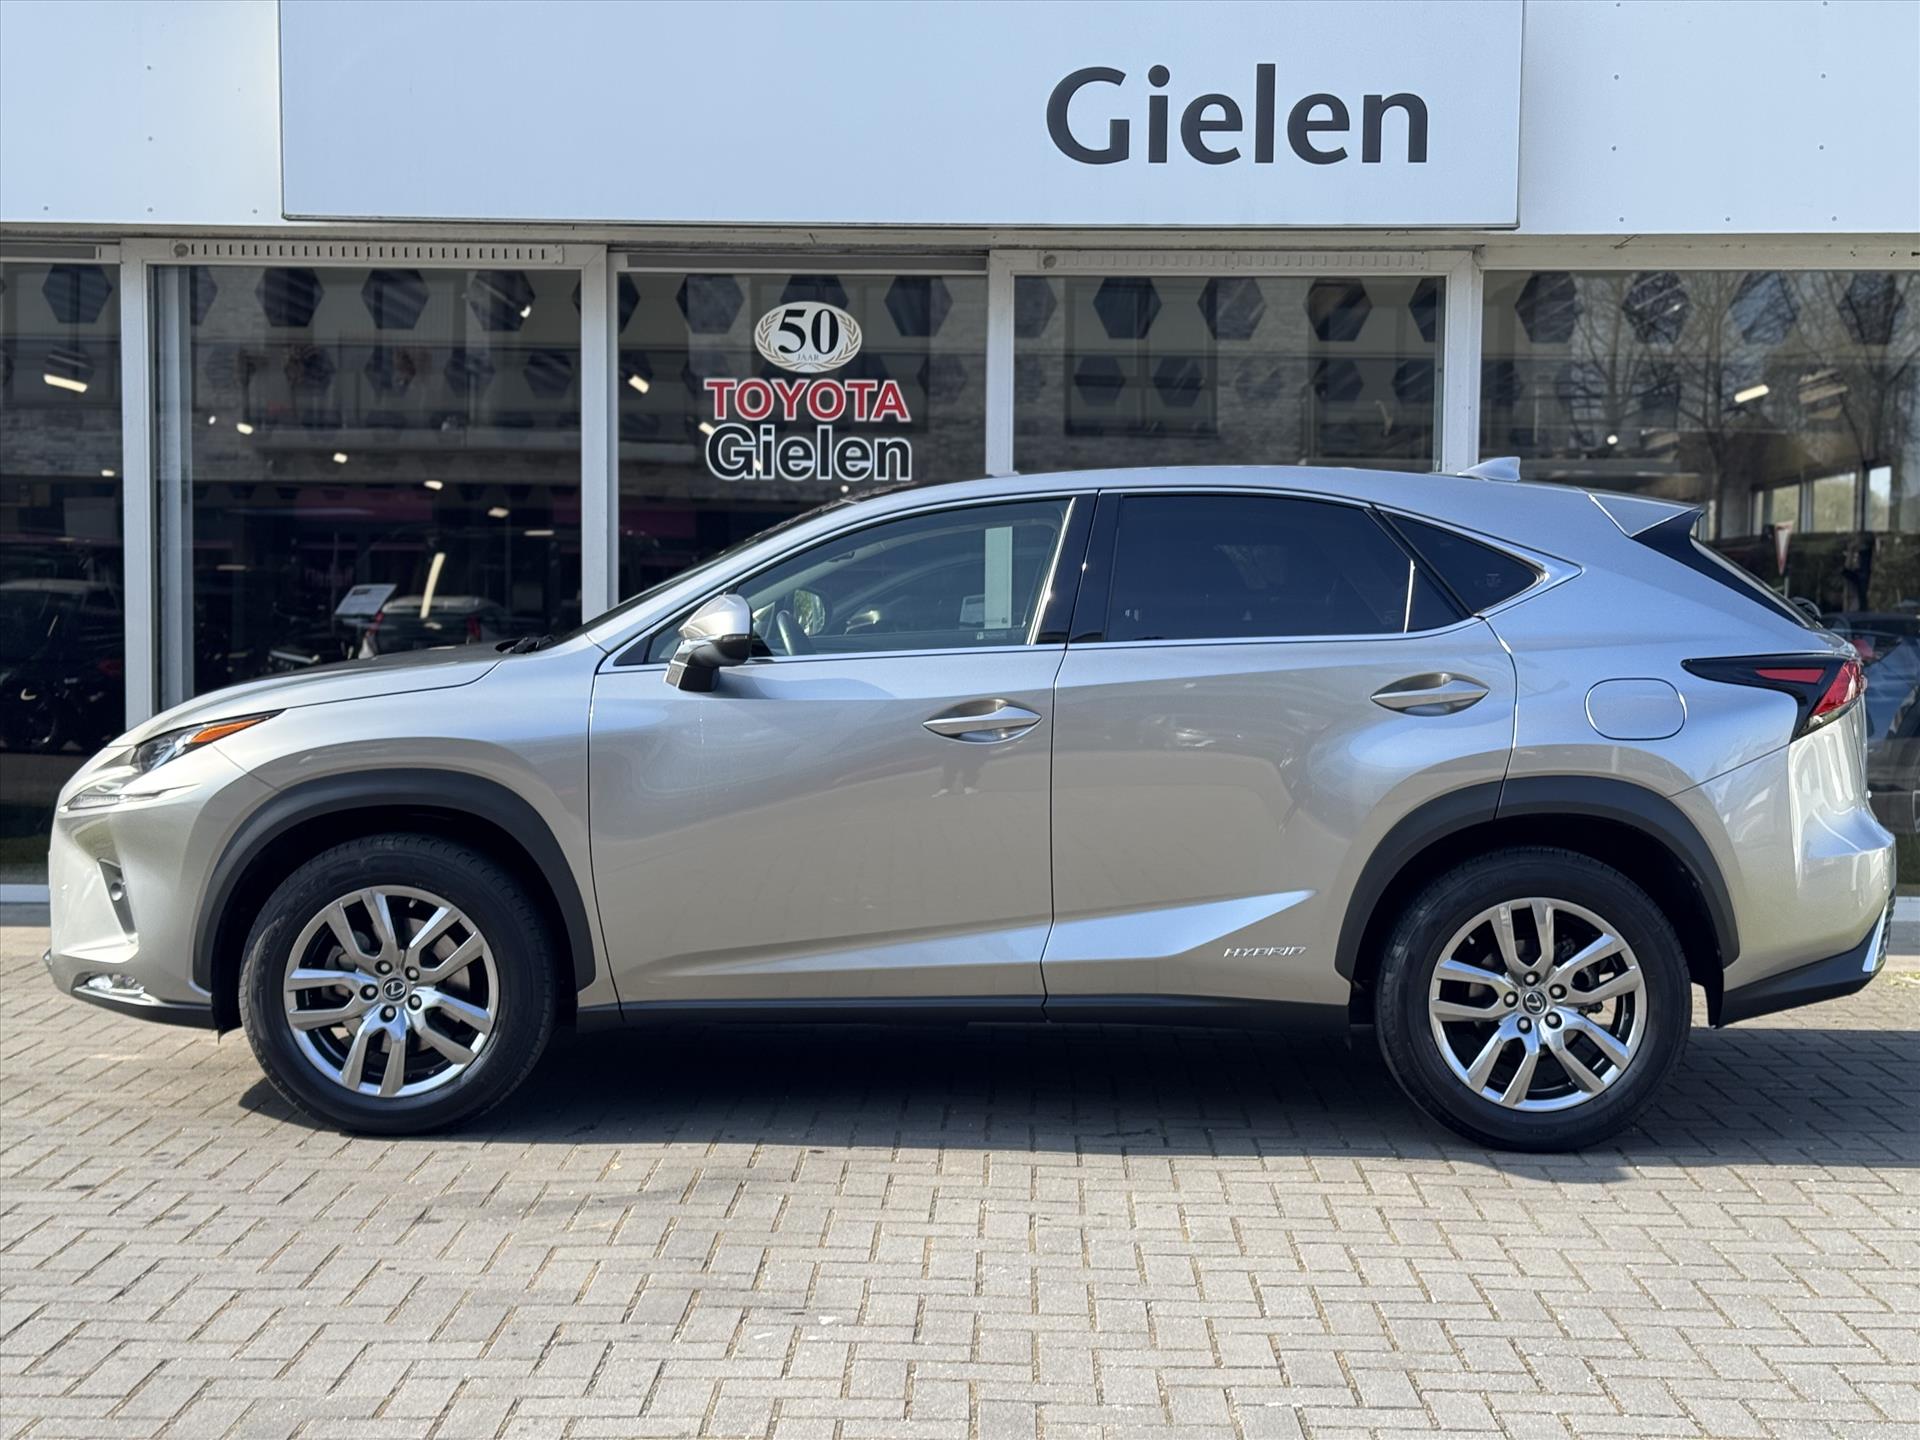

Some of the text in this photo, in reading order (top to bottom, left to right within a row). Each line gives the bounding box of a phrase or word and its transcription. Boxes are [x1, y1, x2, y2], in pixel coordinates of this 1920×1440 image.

[1046, 63, 1428, 165] Gielen
[777, 308, 840, 354] 50
[796, 353, 820, 362] JAAR
[704, 378, 912, 422] TOYOTA
[706, 423, 912, 482] Gielen
[1223, 946, 1307, 958] HYBRID
